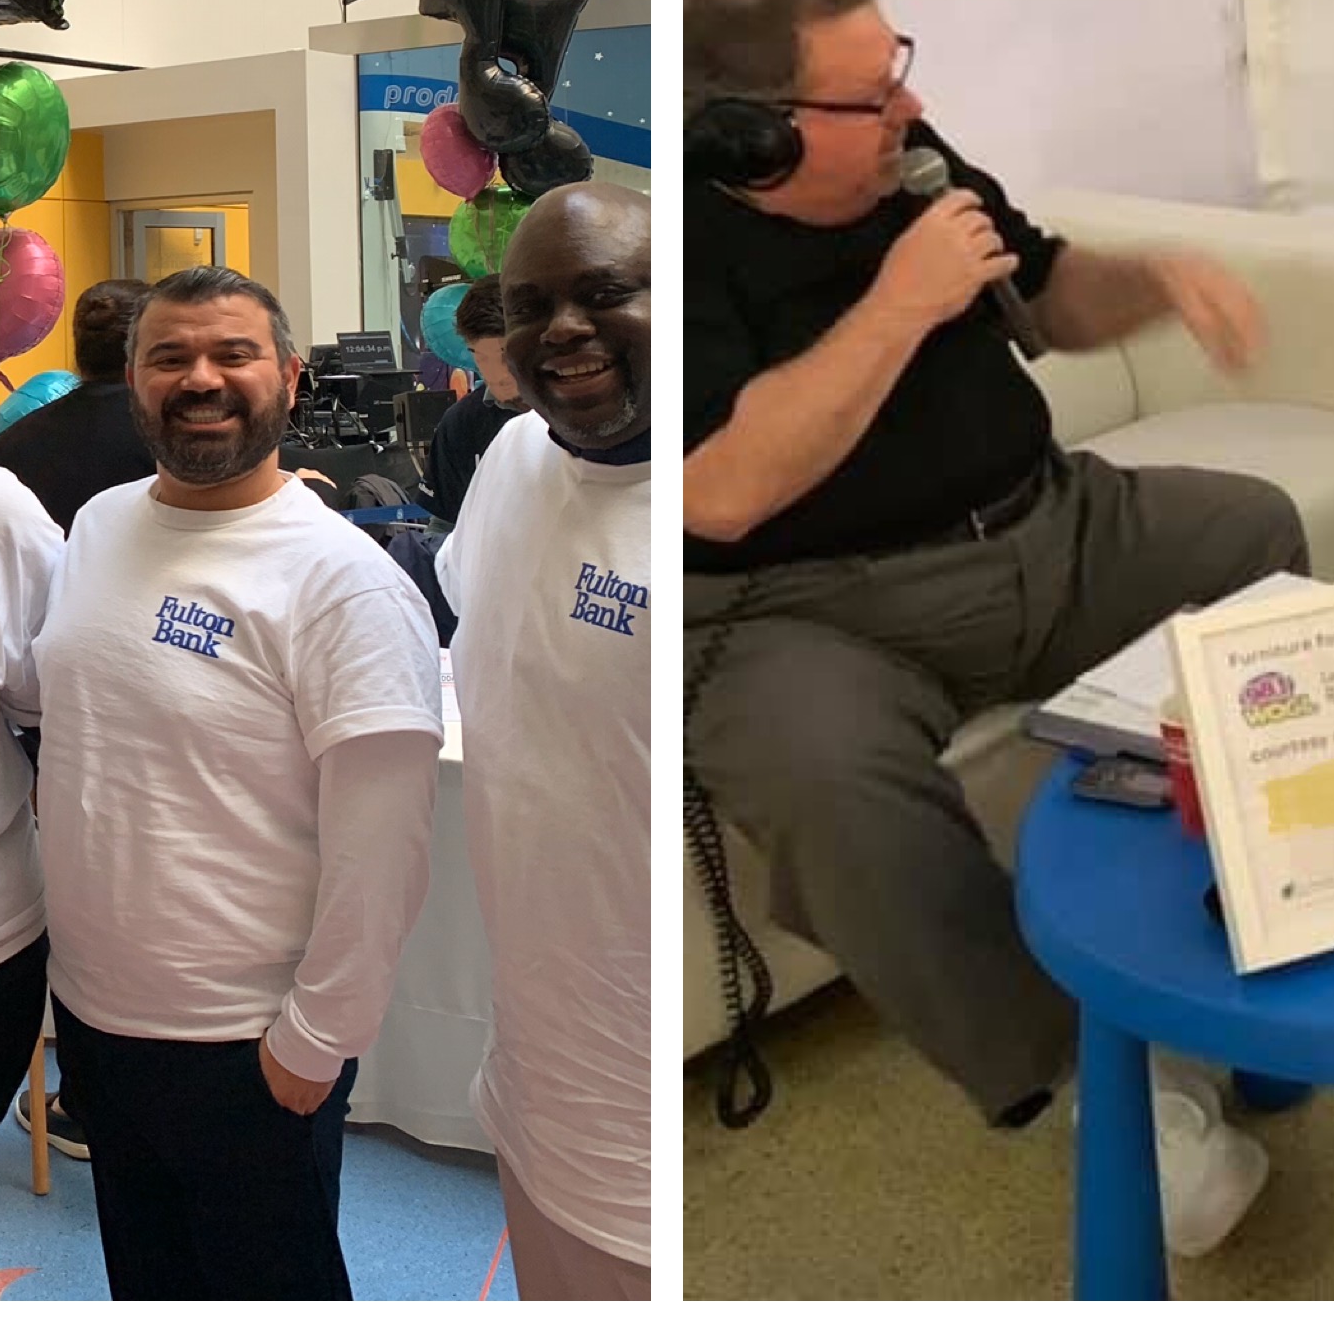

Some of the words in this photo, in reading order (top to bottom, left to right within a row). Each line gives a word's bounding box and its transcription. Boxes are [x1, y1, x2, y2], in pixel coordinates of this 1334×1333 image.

[383, 84, 460, 109] prod
[574, 562, 649, 612] Fulton
[155, 594, 235, 639] Fulton
[569, 597, 636, 637] Bank
[151, 618, 221, 660] Bank
